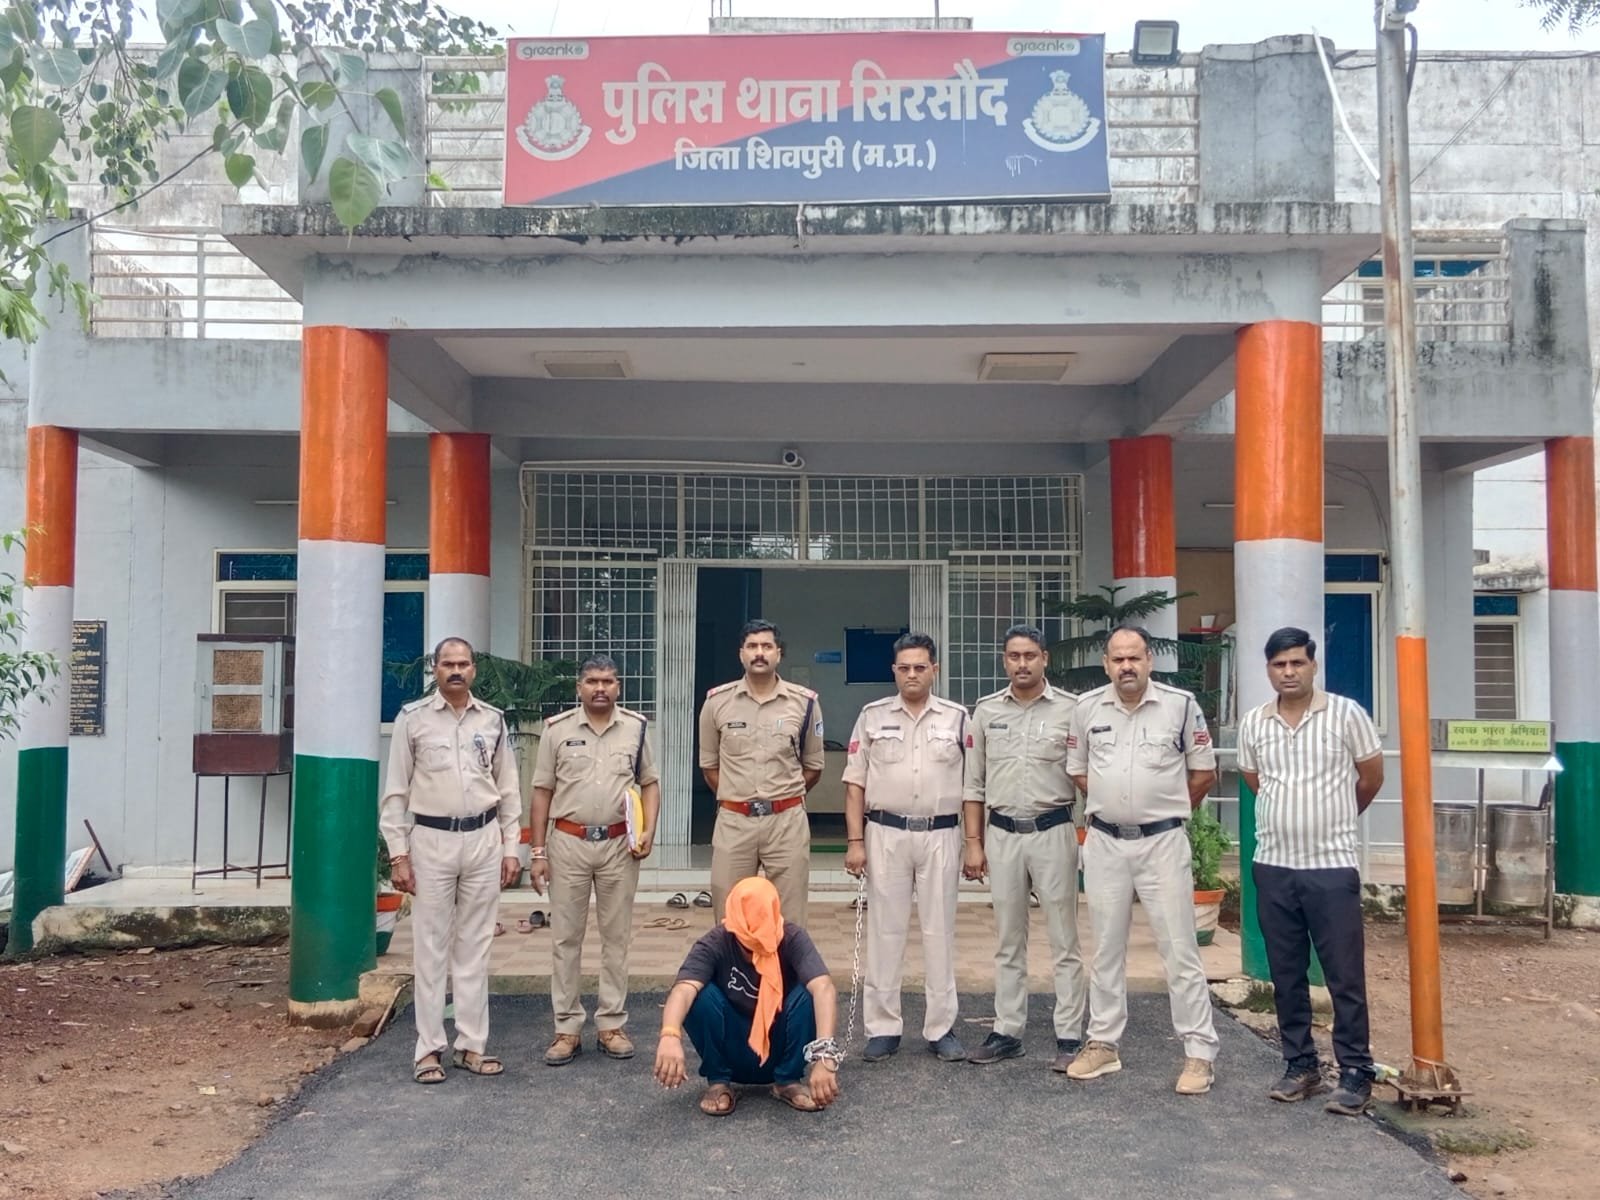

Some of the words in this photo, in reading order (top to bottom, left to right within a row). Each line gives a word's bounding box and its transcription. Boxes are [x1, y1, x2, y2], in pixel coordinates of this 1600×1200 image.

[602, 62, 726, 145] पुलिस
[737, 77, 840, 122] थाना
[849, 58, 1008, 126] सिरसौद
[674, 137, 741, 170] जिला
[746, 135, 845, 180] शिवपुरी
[852, 138, 937, 173] (म.प्र.)
[1482, 726, 1506, 736] भारत
[1510, 723, 1546, 737] अभियान
